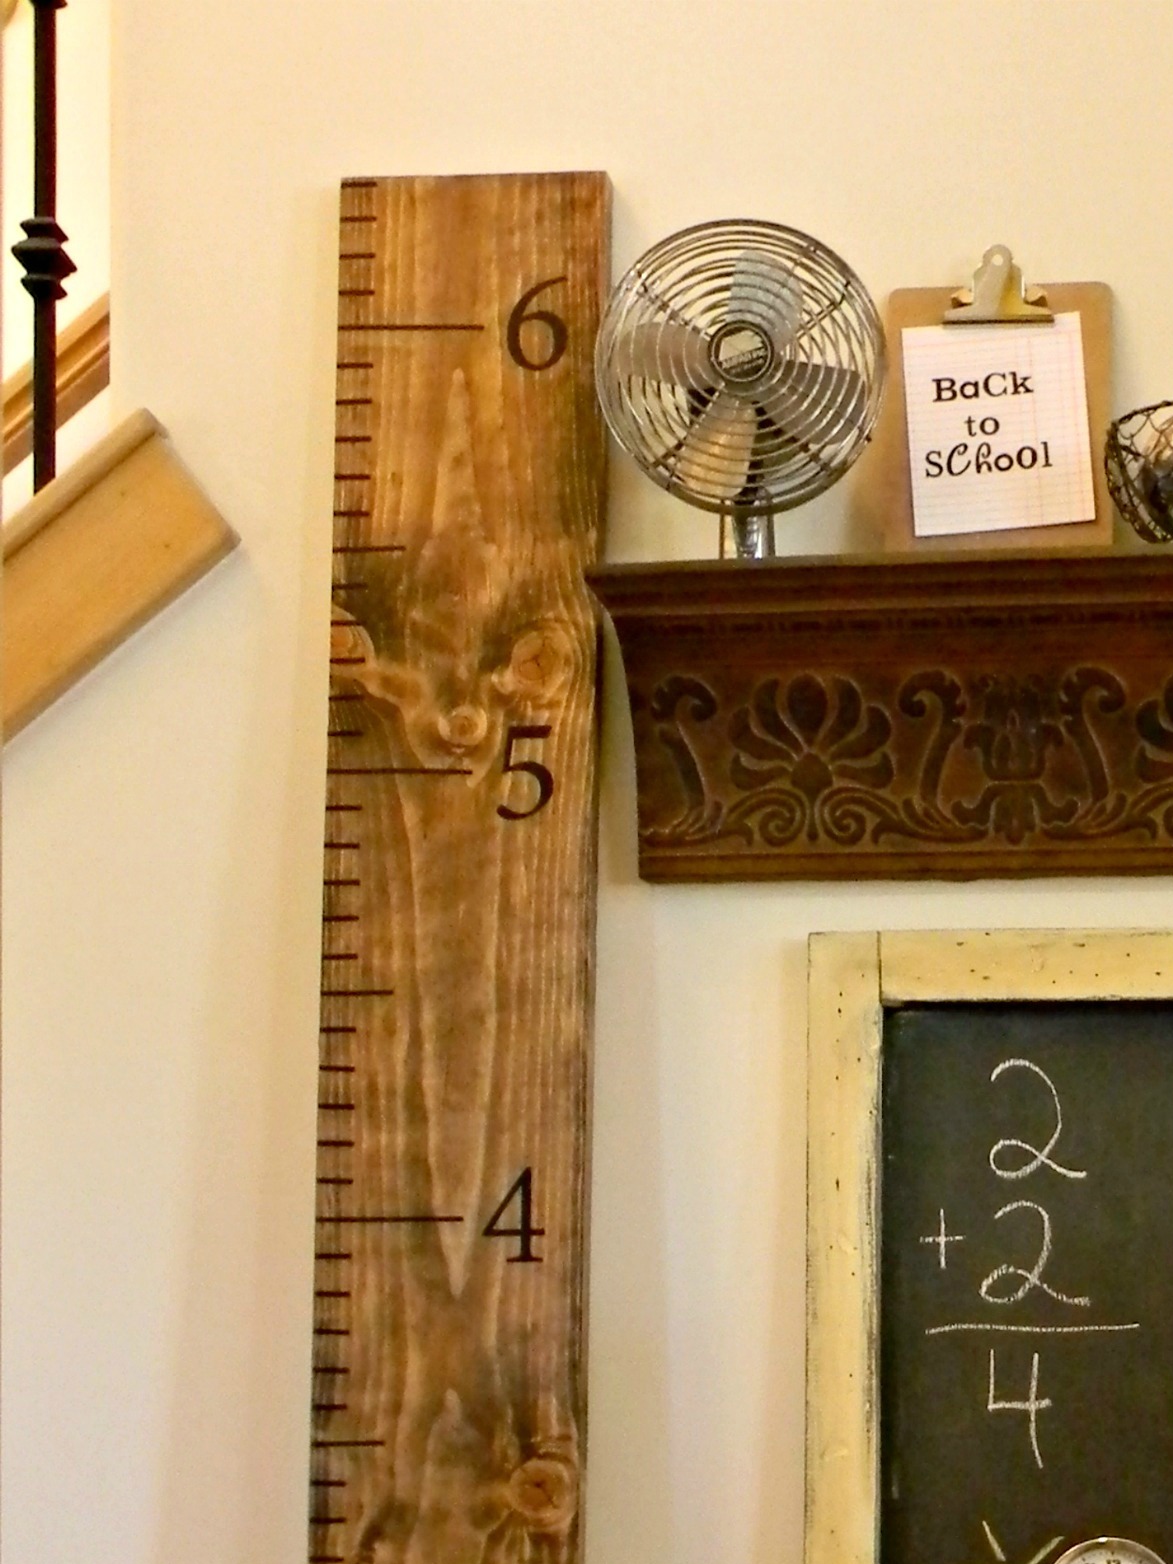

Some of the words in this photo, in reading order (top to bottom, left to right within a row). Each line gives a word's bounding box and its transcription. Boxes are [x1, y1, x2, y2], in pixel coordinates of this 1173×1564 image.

[507, 276, 568, 371] 6
[931, 371, 1034, 402] BaCk
[964, 415, 1000, 437] to
[496, 723, 555, 822] 5
[990, 1058, 1088, 1179] 2
[482, 1166, 546, 1264] 4
[986, 1348, 1052, 1470] 4
